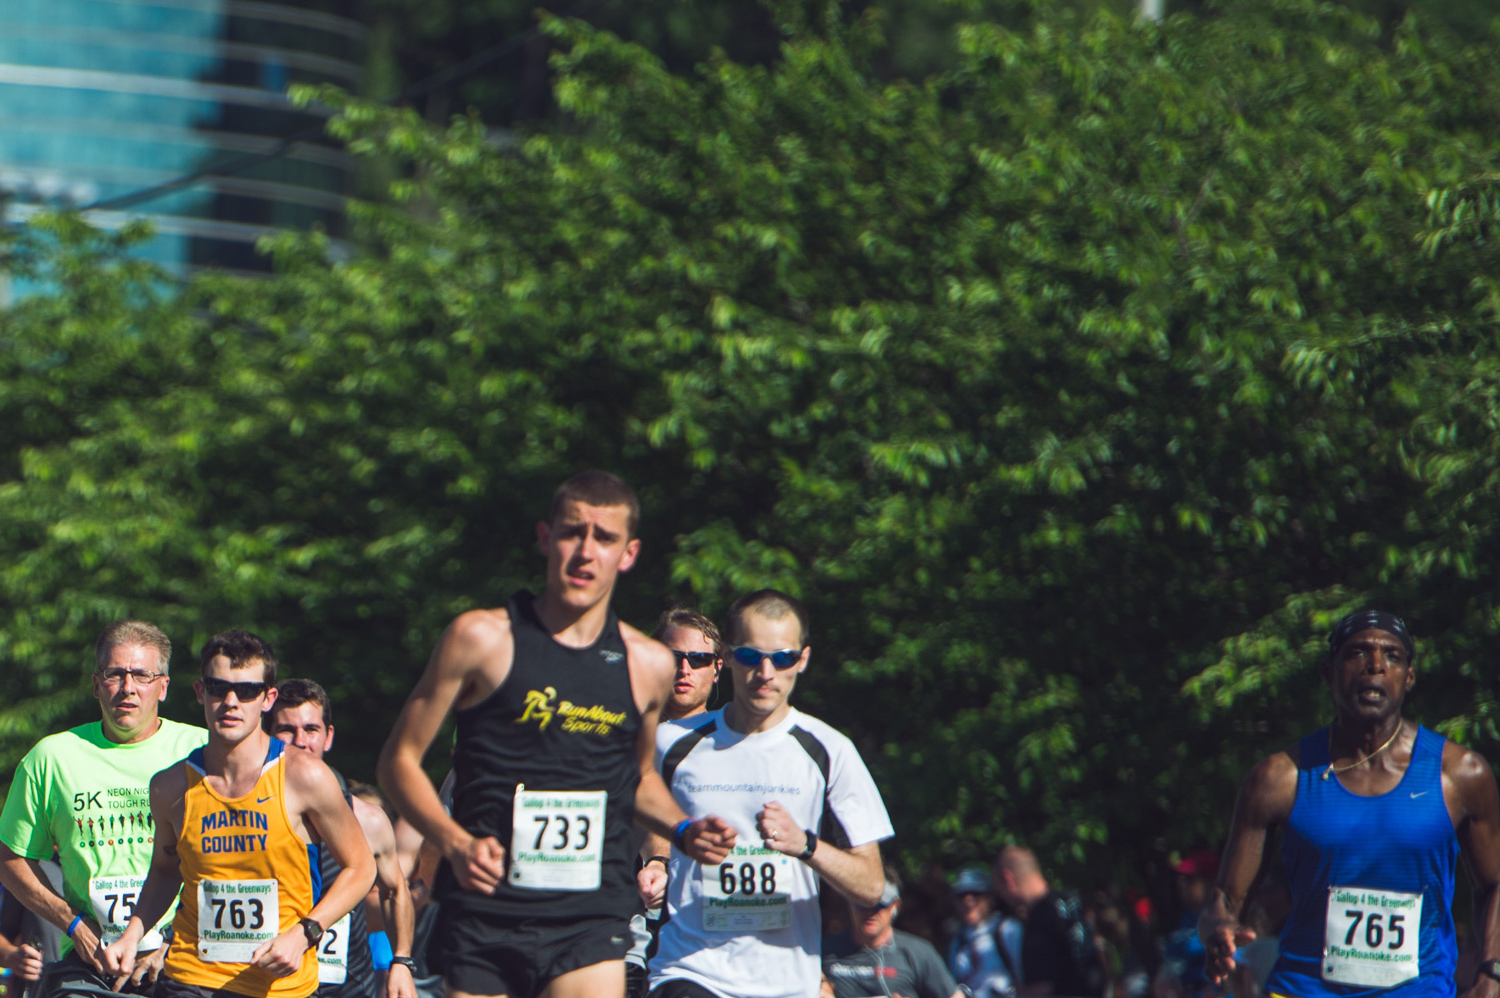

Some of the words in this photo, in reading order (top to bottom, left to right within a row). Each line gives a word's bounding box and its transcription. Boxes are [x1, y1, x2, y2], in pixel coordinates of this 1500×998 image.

[556, 701, 627, 725] RunAbout
[561, 716, 612, 736] Sports
[73, 791, 103, 812] 5K
[107, 788, 131, 797] NEON
[108, 799, 138, 809] TOUGH
[140, 799, 150, 808] RU
[200, 809, 268, 835] MARTIN
[533, 815, 590, 850] 733
[201, 834, 268, 854] COUNTY
[736, 846, 747, 855] the
[518, 852, 596, 863] PlayRoanoke.com
[95, 880, 112, 891] Gallop
[119, 880, 129, 888] the
[719, 862, 776, 895] 688
[221, 883, 225, 893] 4
[226, 884, 236, 893] the
[238, 883, 271, 895] Greenways
[1336, 889, 1359, 905] Gallop
[1367, 894, 1378, 905] the
[1381, 895, 1415, 909] Greenways
[104, 893, 136, 924] 75
[709, 897, 787, 909] PlayRoanoke.com
[211, 898, 264, 930] 763
[203, 930, 273, 941] PlayRoanoke.com
[1344, 910, 1405, 950] 765
[1331, 945, 1412, 962] PlayRoanoke.com
